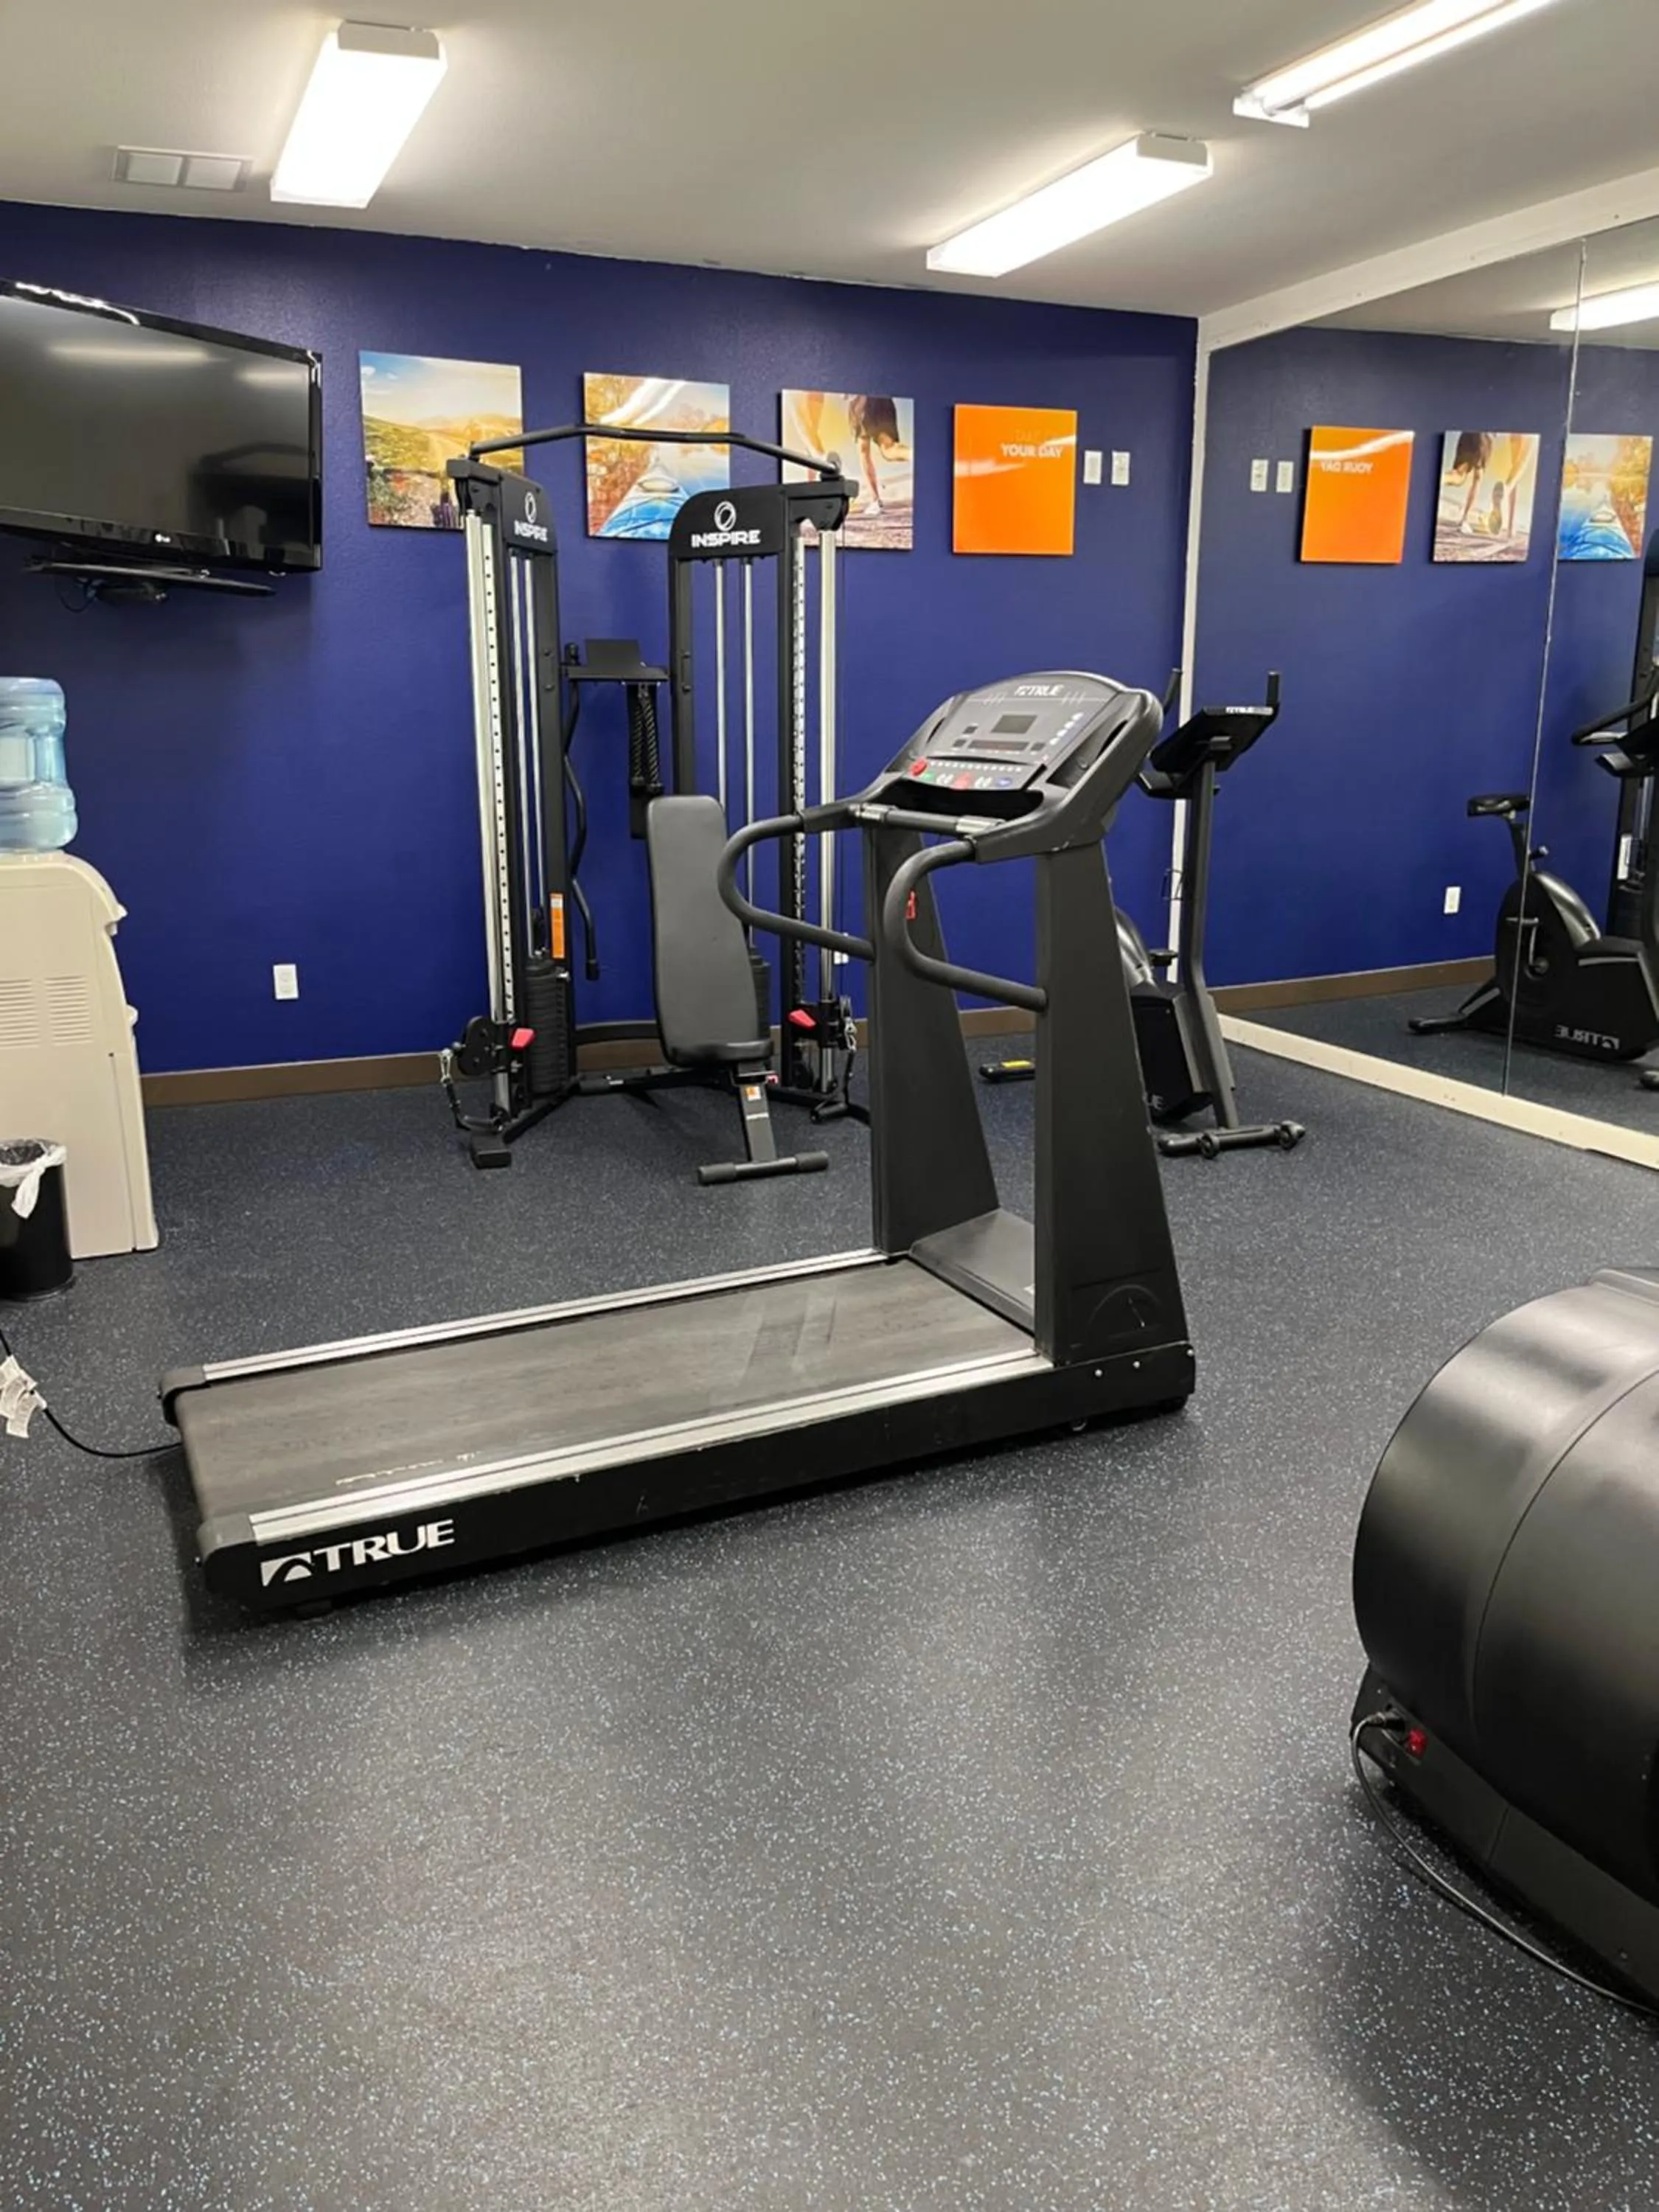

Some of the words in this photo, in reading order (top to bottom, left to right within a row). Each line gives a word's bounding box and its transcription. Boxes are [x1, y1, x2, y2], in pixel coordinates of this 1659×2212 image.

[1001, 442, 1036, 457] YOUR
[1037, 444, 1062, 458] DAY
[514, 520, 548, 542] INSPIRE
[691, 529, 761, 548] INSPIRE
[313, 1519, 455, 1572] TRUE
